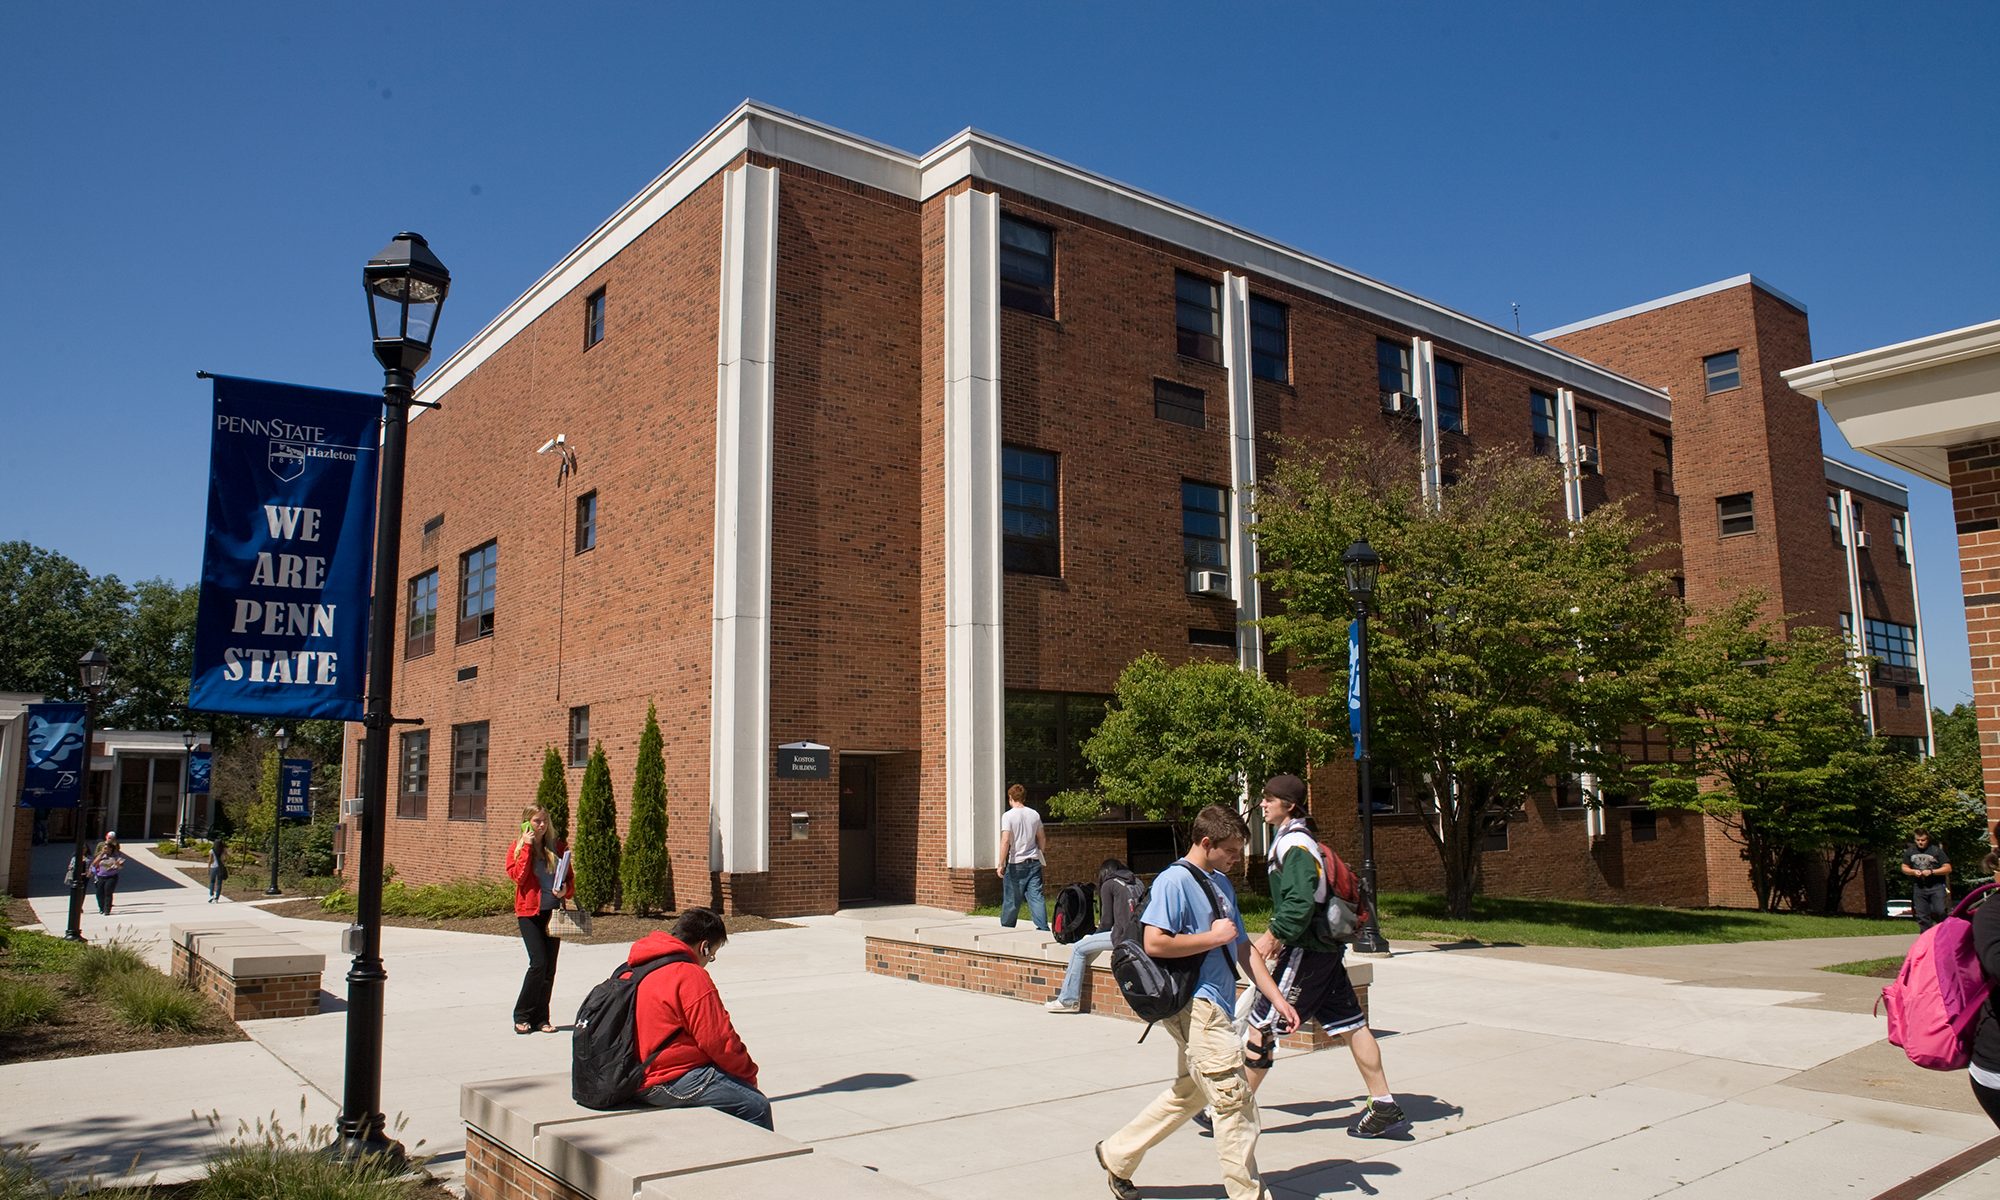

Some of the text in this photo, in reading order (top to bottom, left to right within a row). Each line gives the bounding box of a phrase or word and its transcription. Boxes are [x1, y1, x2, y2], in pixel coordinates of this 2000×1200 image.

[307, 447, 357, 461] Hazleton
[264, 505, 322, 542] WE
[251, 551, 326, 589] ARE
[231, 599, 337, 637] PENN
[223, 647, 338, 685] STATE
